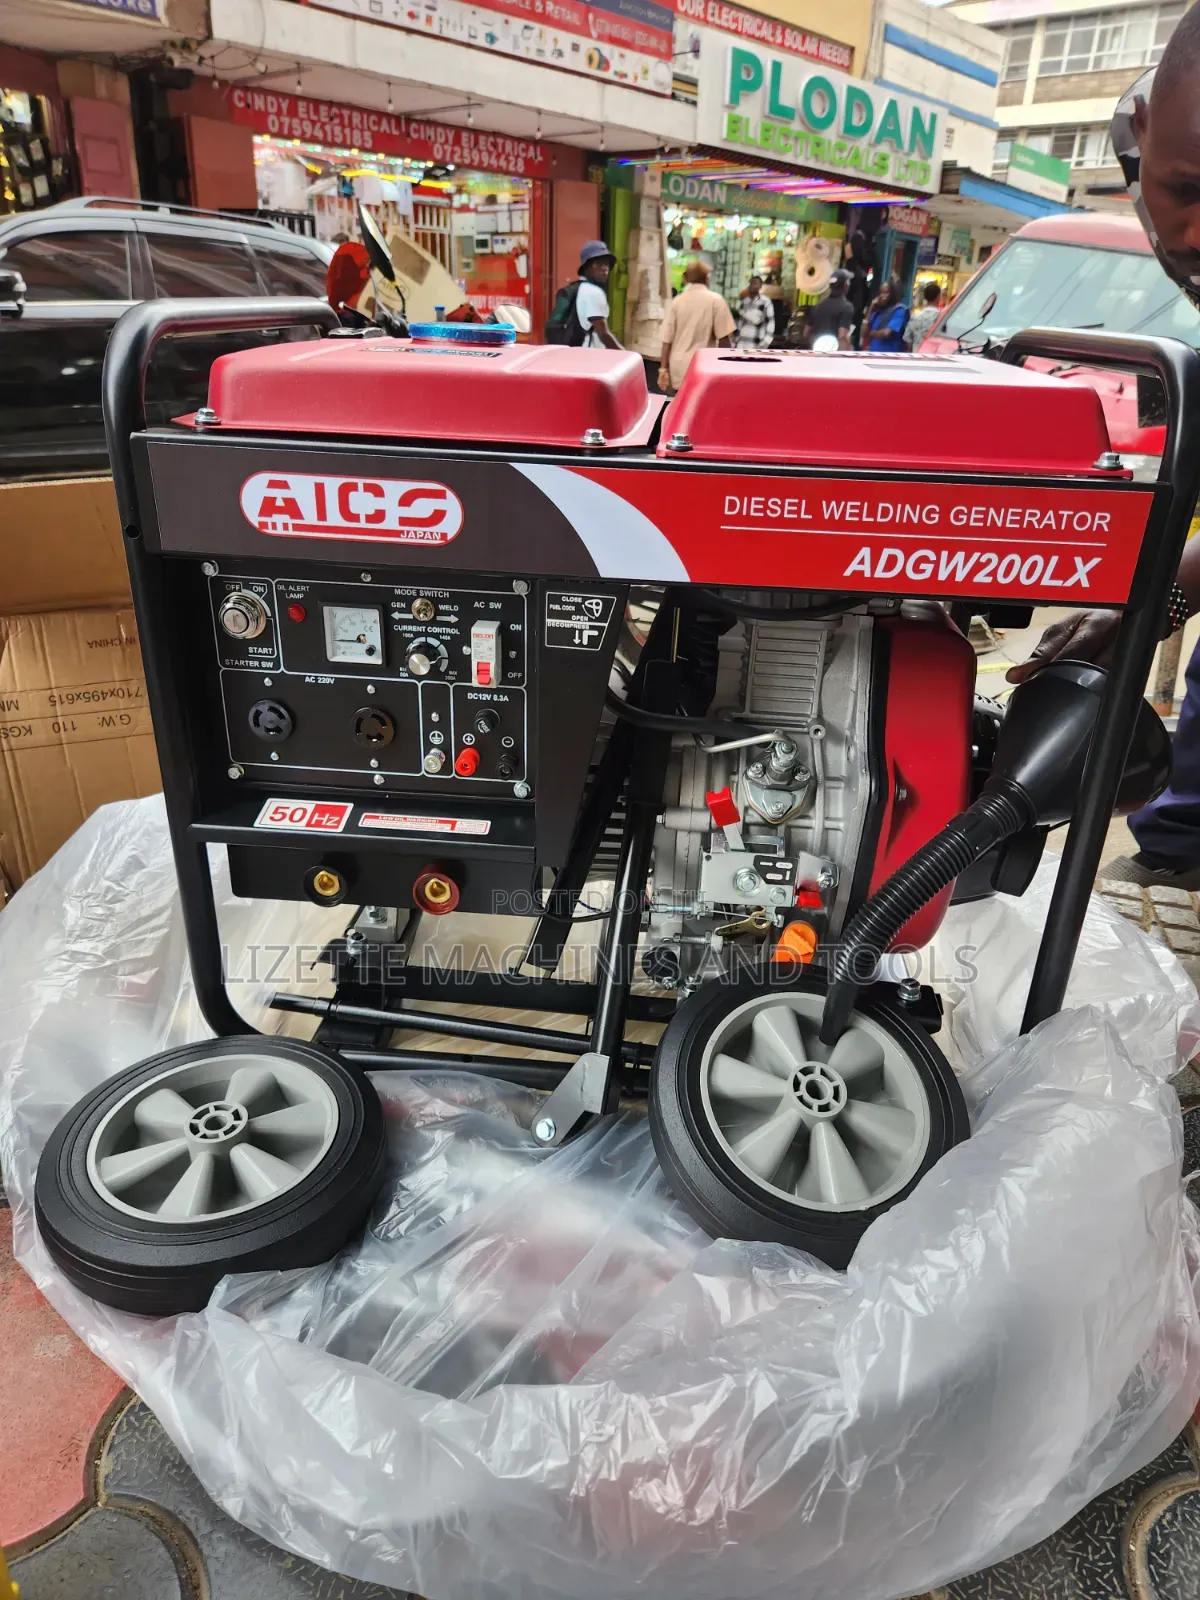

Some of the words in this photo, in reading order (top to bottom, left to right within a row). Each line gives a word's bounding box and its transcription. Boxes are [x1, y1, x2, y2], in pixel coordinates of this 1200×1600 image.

[545, 1, 581, 26] RETAIL
[706, 0, 774, 42] ELECTRICAL
[773, 26, 782, 44] &
[784, 28, 818, 57] SOLAR
[819, 40, 850, 66] NEEDS
[233, 89, 290, 114] CINDY
[297, 101, 400, 136] ELECTRICAL
[726, 46, 938, 158] PLODAN
[267, 114, 373, 148] 0759415185
[409, 122, 455, 146] CINDY
[461, 131, 543, 161] ELECTRICAL
[433, 143, 525, 173] 0725994428
[723, 111, 890, 177] ELECTRICALS
[895, 158, 932, 185] LTD
[257, 479, 448, 528] AICS
[723, 496, 813, 519] DIESEL
[821, 500, 940, 525] WELDING
[949, 506, 1111, 532] GENERATOR
[400, 530, 442, 541] JAPAN
[843, 546, 1103, 588] ADGW200LX
[394, 588, 417, 597] MODE
[419, 590, 450, 599] SWITCH
[393, 625, 426, 633] CURRENT
[427, 626, 460, 635] CONTROL
[87, 637, 121, 648] CHINA
[248, 646, 273, 655] START
[225, 658, 260, 667] STARTER
[317, 677, 335, 685] 220V
[48, 686, 143, 707] 710x495x615
[467, 693, 491, 701] DC12V
[493, 694, 509, 702] 8.3A
[52, 720, 77, 733] 110
[479, 720, 490, 733] FUSE
[269, 806, 307, 824] 50
[310, 812, 340, 827] Hz
